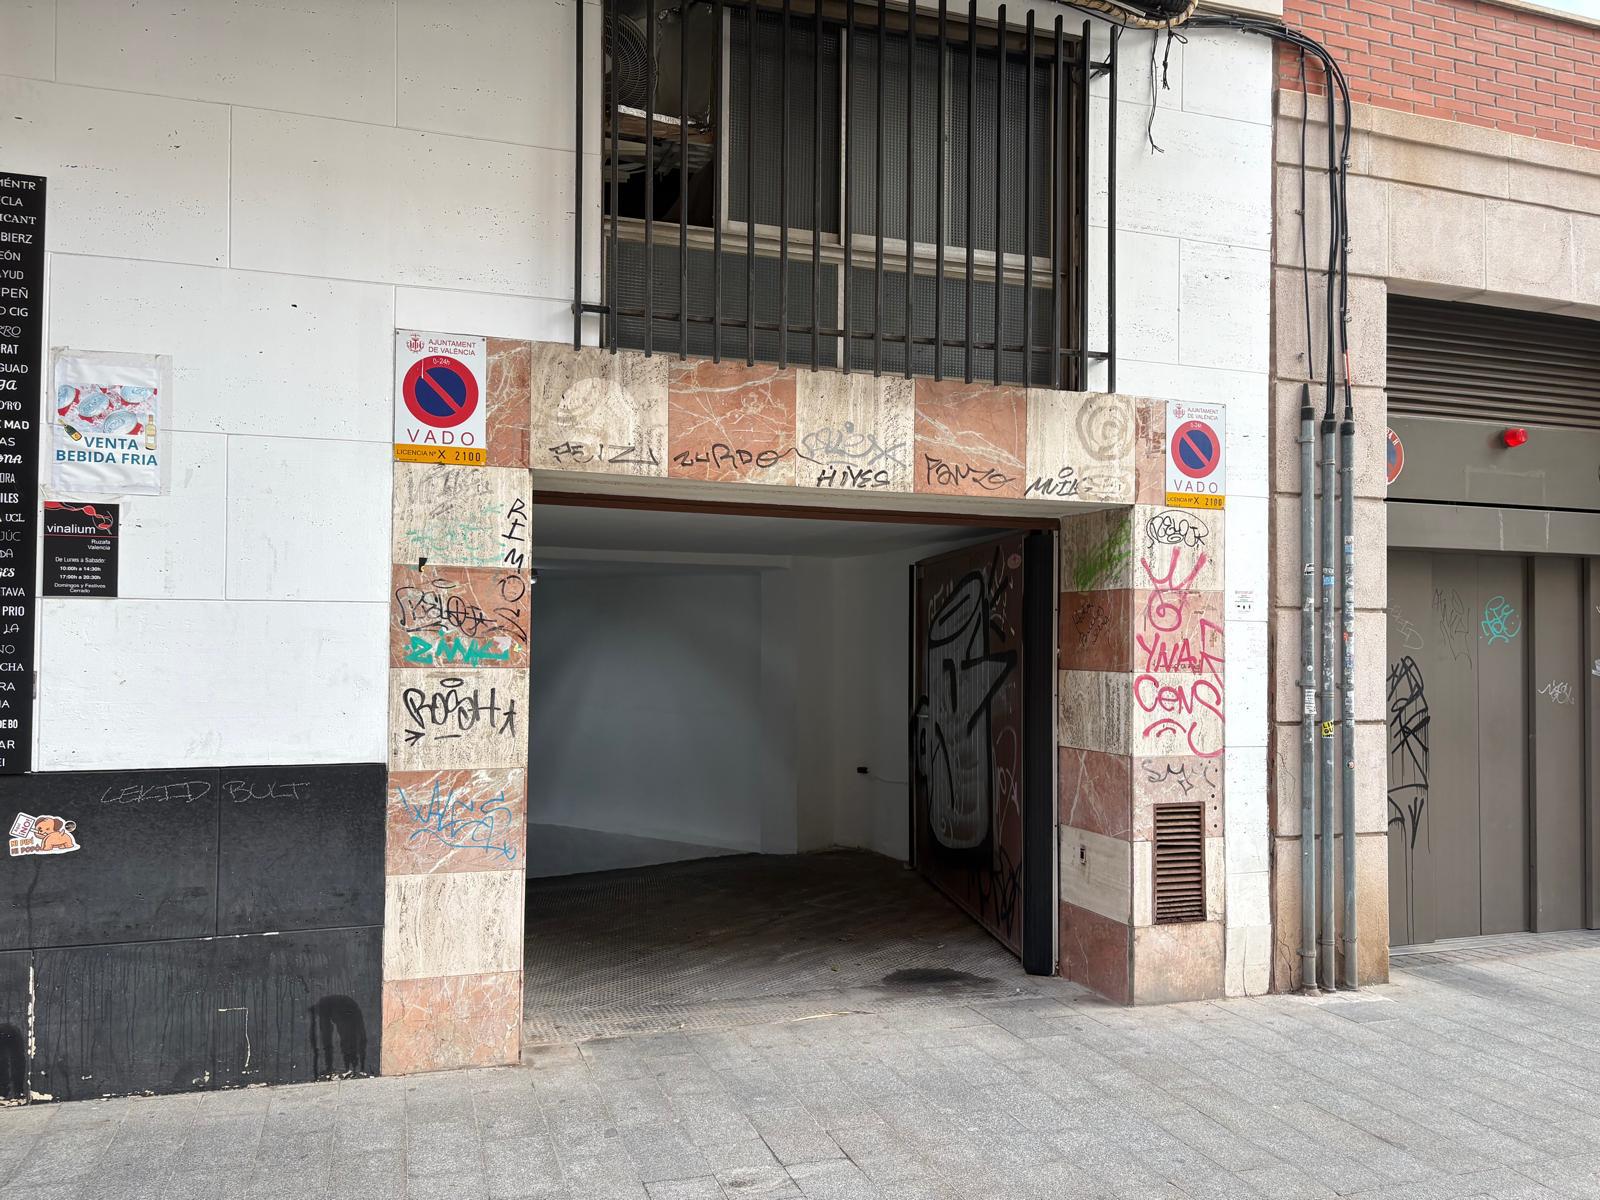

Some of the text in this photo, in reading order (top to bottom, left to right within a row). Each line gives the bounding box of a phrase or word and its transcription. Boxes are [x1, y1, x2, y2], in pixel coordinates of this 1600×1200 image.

[0, 196, 23, 206] CLA
[1, 232, 32, 244] BIERZ
[0, 270, 24, 280] YUD
[2, 286, 28, 299] PEÑ
[9, 307, 28, 317] CIG
[428, 339, 476, 348] AJUNTAMENT
[1, 344, 19, 354] RAT
[4, 420, 30, 430] MAD
[406, 428, 475, 446] VADO
[84, 436, 139, 450] VENTA
[56, 450, 158, 466] BEBIDA FRIA
[437, 450, 446, 460] X
[455, 451, 480, 462] 2100
[1174, 480, 1218, 493] VADO
[47, 524, 95, 534] vinalium
[1, 587, 25, 597] TAVA
[2, 606, 24, 616] PRIO
[0, 662, 24, 672] CHA
